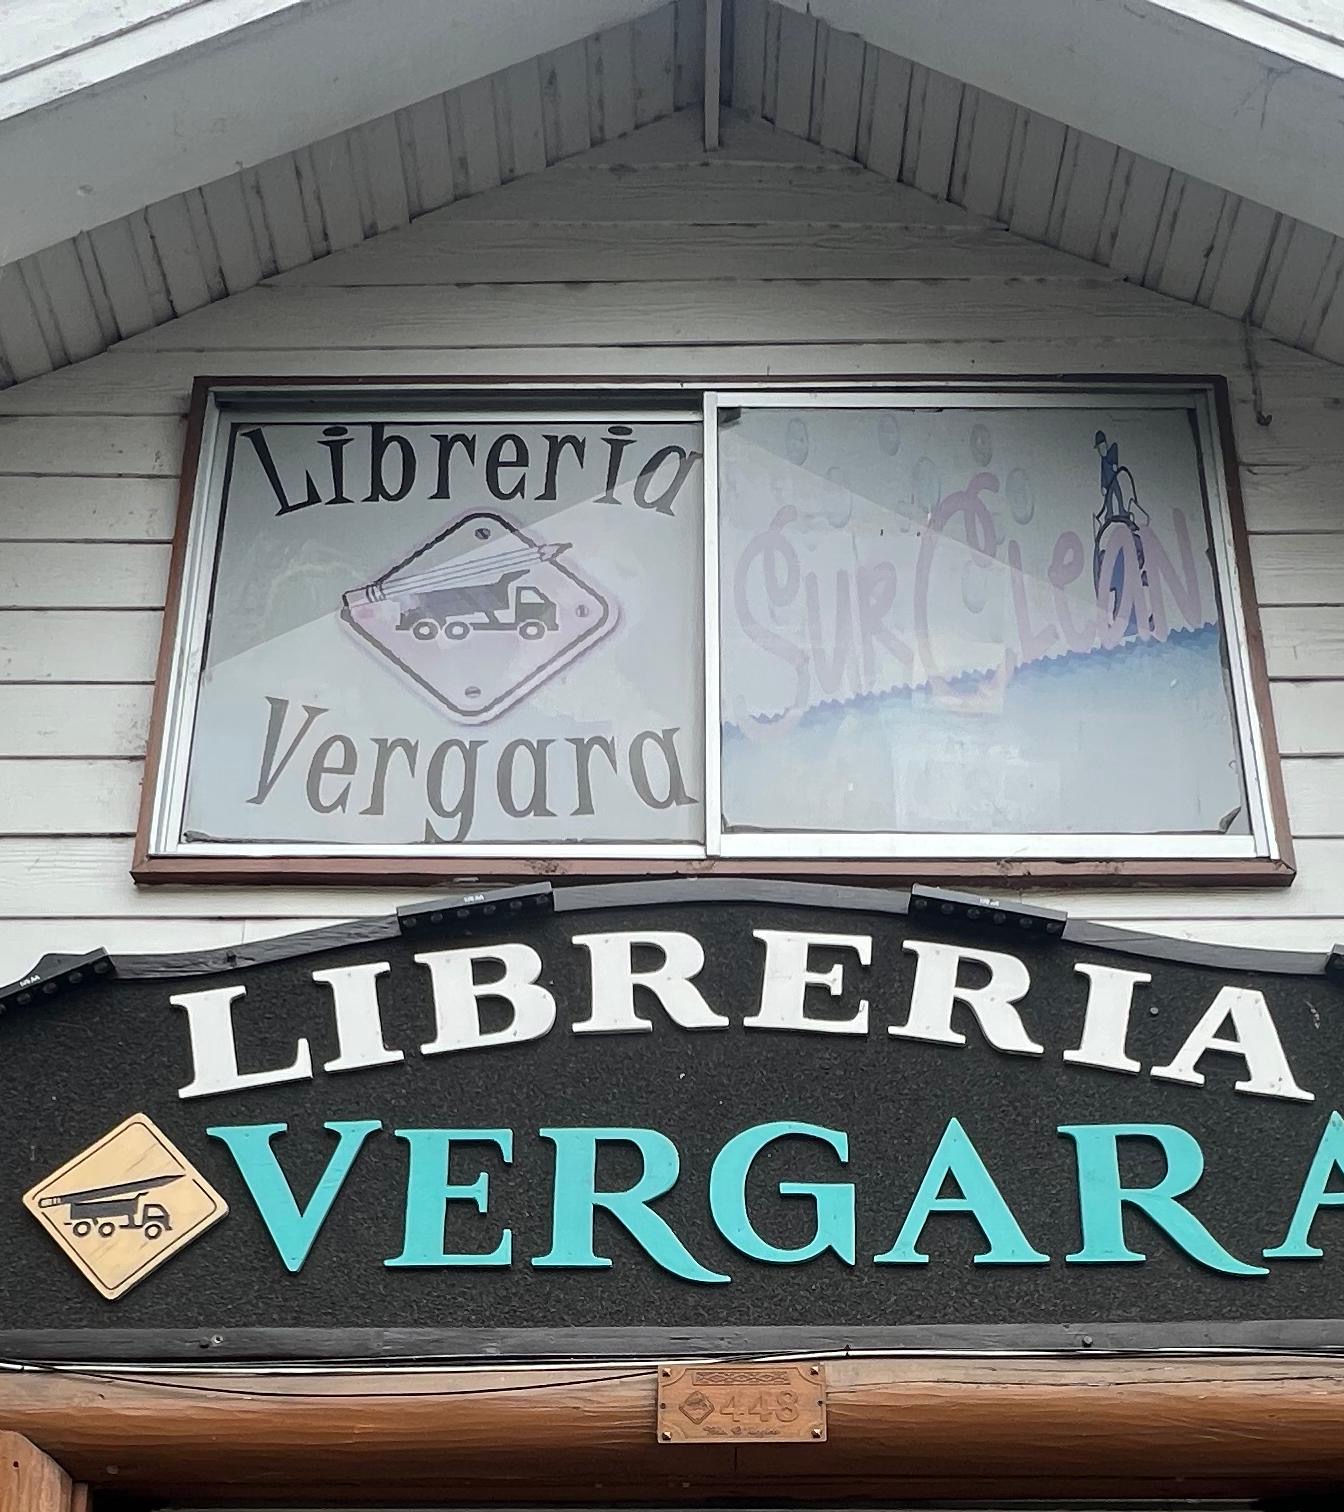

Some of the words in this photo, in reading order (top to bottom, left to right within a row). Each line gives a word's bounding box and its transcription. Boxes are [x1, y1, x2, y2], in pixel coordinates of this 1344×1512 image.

[238, 422, 704, 516] Libreria
[246, 697, 700, 842] Vergara
[167, 929, 1314, 1103] LIBRERIA
[720, 1390, 799, 1422] 448
